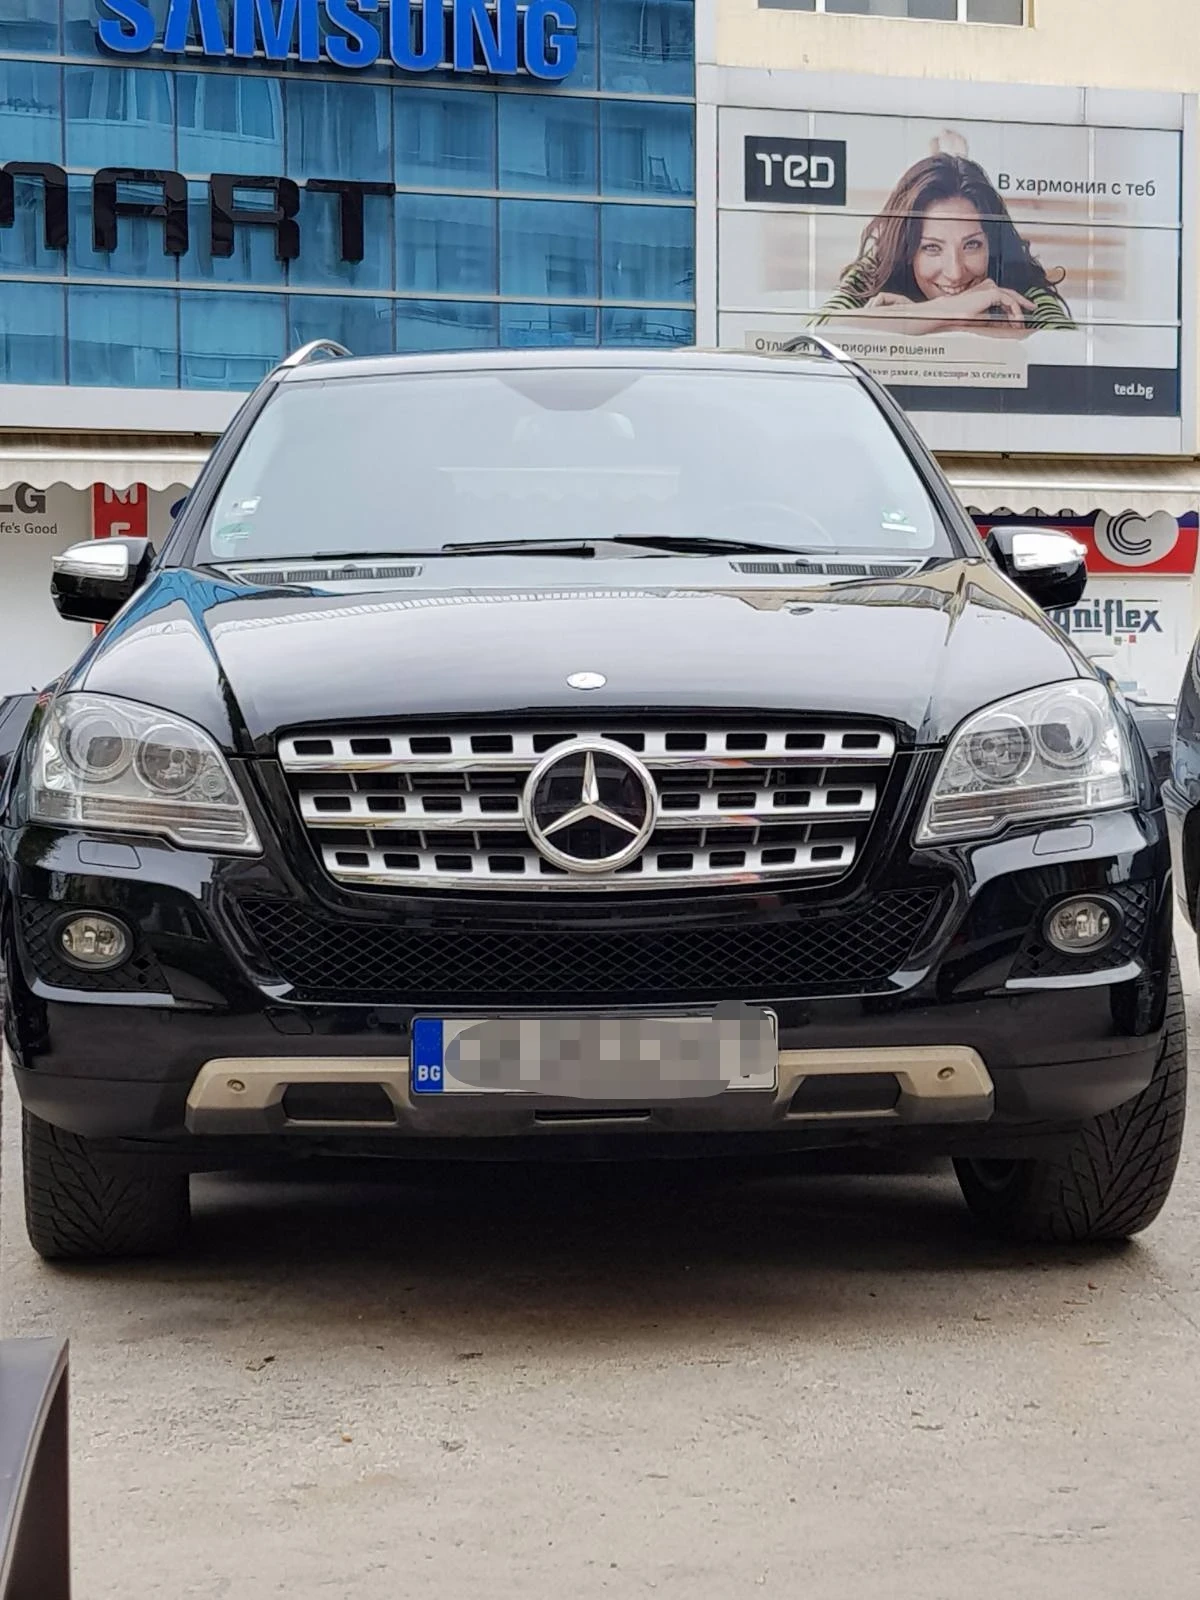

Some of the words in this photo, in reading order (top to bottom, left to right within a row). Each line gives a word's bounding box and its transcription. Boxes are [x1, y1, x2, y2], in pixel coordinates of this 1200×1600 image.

[98, 0, 578, 80] SAMSUNG
[998, 173, 1010, 190] В
[1015, 176, 1107, 195] хармония
[1111, 182, 1121, 195] с
[1125, 180, 1156, 197] теб
[1114, 383, 1154, 400] ted.bg
[24, 522, 58, 535] Good
[1046, 599, 1163, 636] gniflex
[418, 1064, 441, 1082] BG
